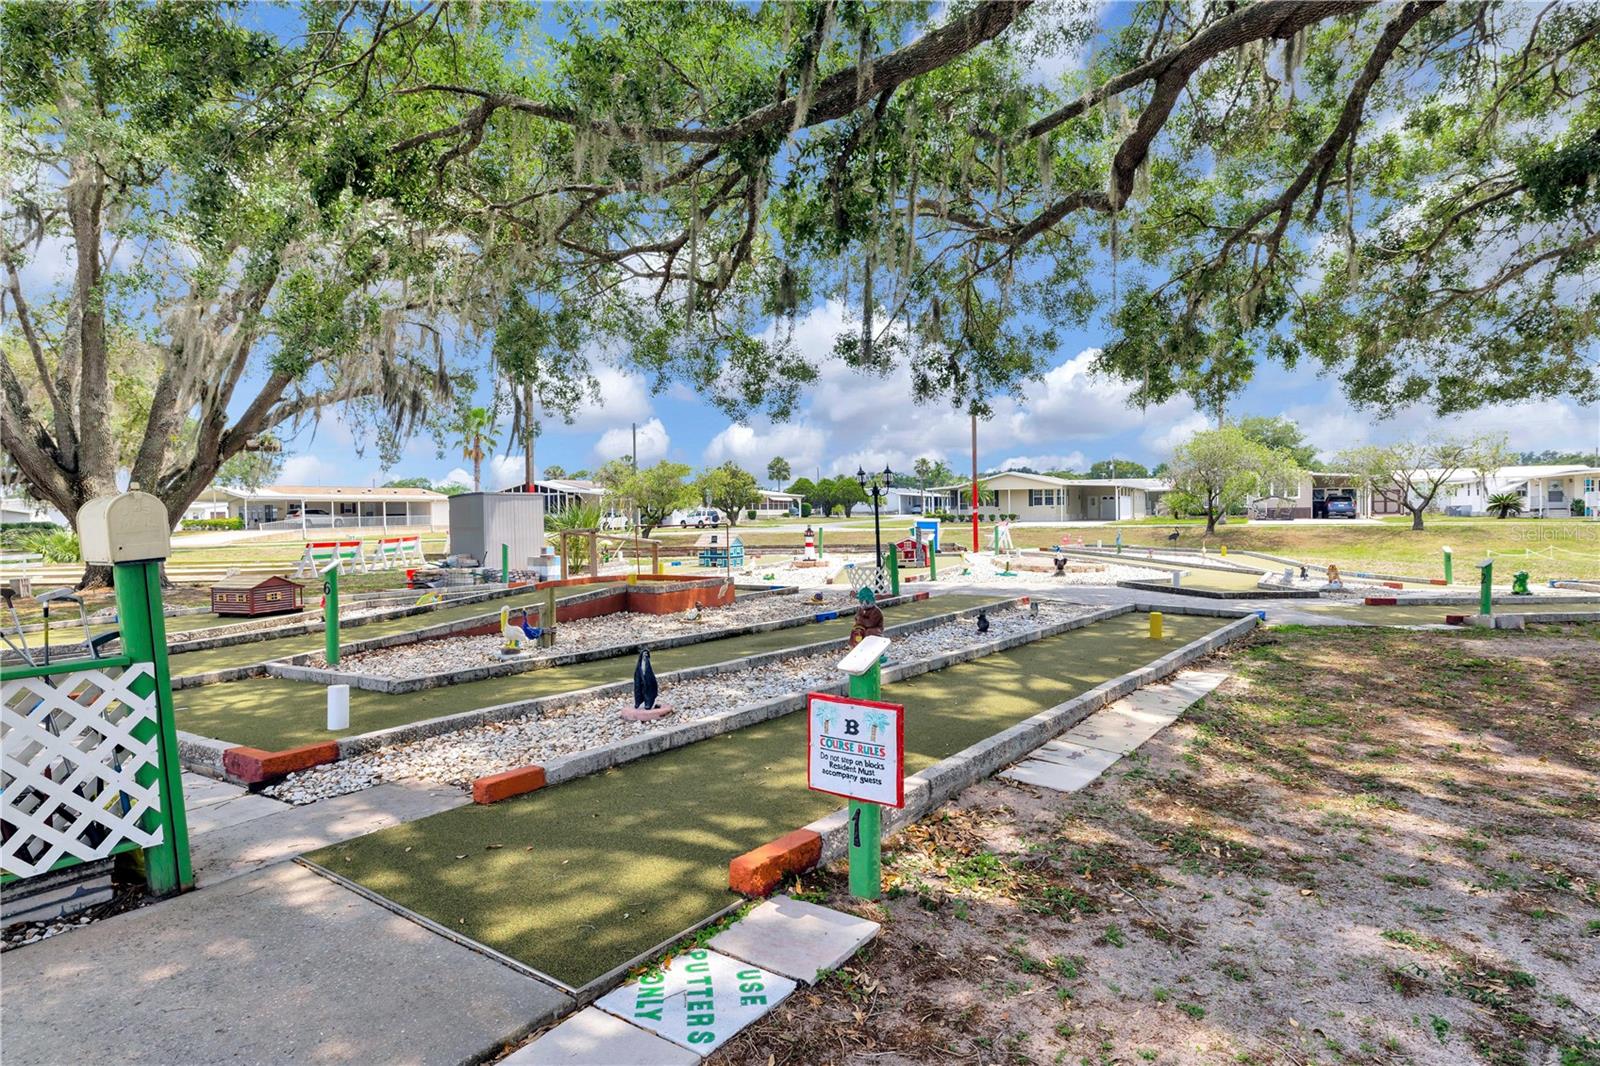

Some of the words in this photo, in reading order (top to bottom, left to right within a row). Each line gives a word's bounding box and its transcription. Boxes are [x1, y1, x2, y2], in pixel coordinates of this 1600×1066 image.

[323, 581, 331, 595] 6
[844, 718, 860, 735] B
[820, 737, 854, 752] COURSE
[857, 743, 886, 757] RULES
[820, 751, 828, 760] Do
[829, 755, 840, 763] not
[841, 757, 854, 765] step
[864, 759, 885, 770] blocks
[829, 761, 857, 774] Resident
[857, 767, 875, 776] Must
[822, 768, 858, 782] accompany
[859, 776, 882, 785] guests
[851, 808, 861, 848] 1
[634, 973, 665, 1022] ONLY
[684, 949, 715, 1044] PUTTERS
[735, 969, 767, 1007] USE
